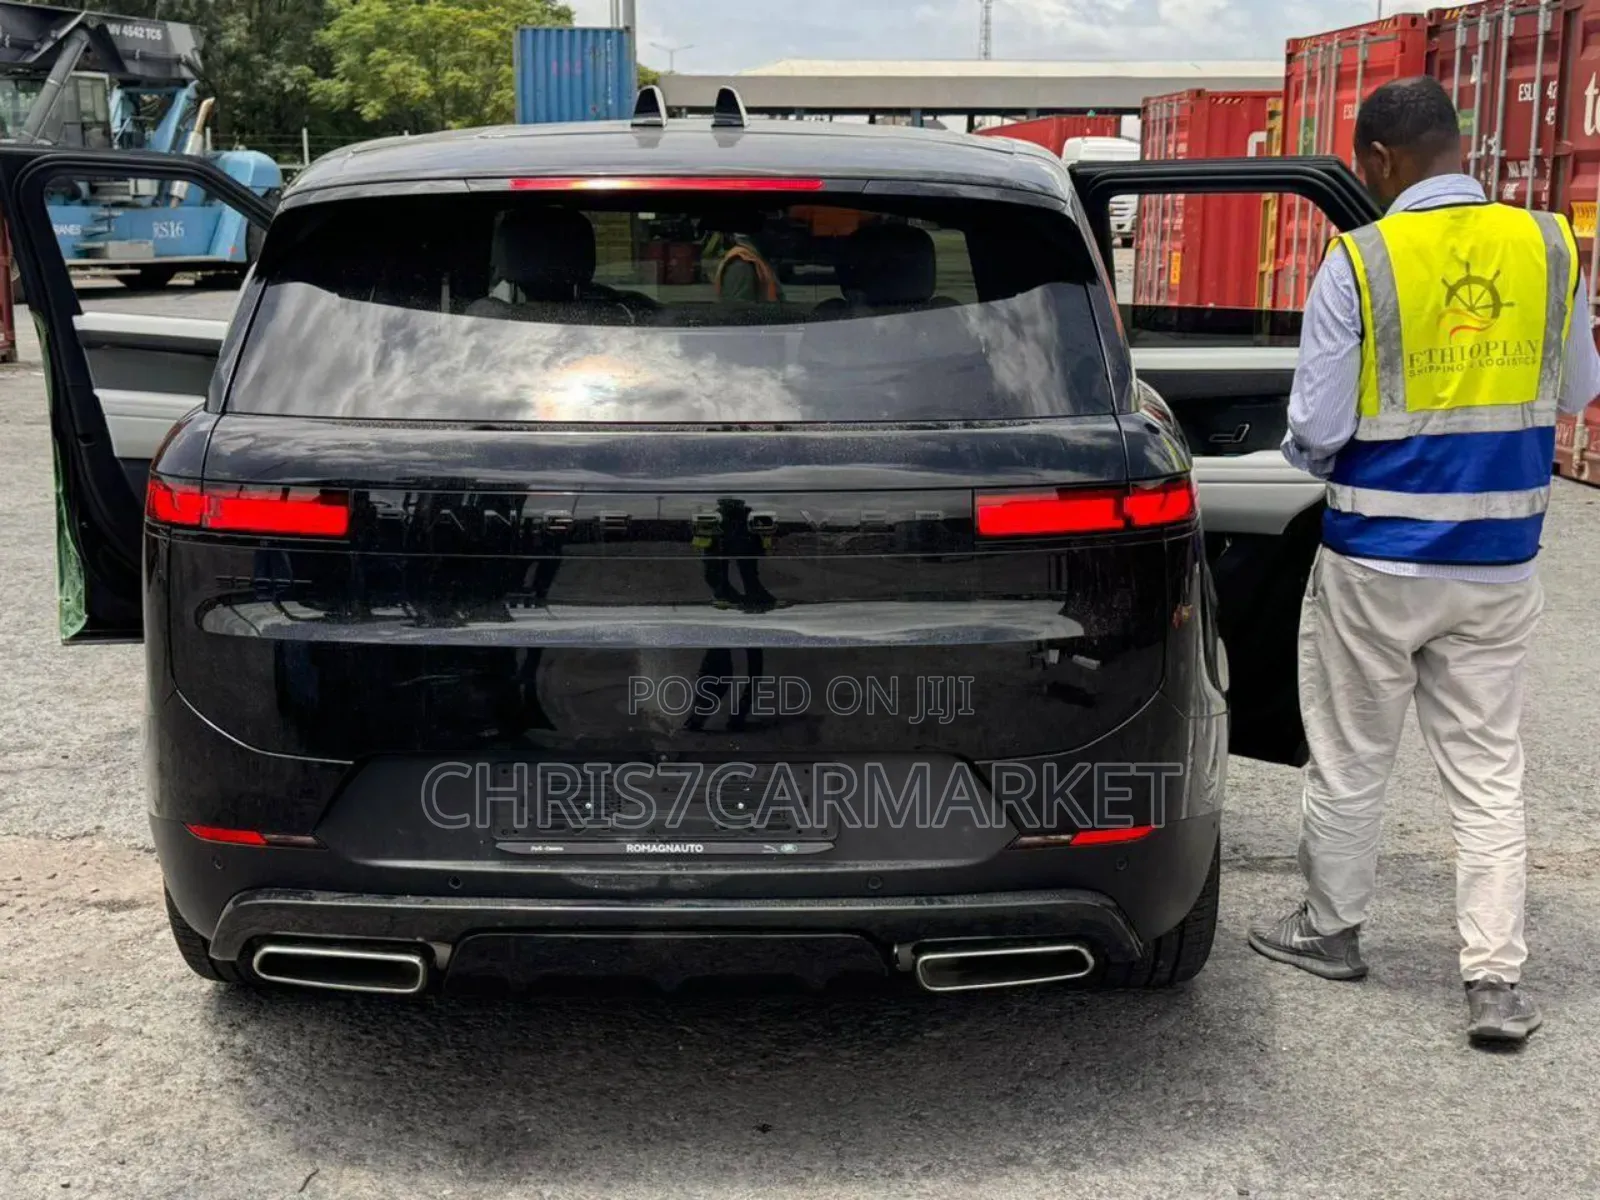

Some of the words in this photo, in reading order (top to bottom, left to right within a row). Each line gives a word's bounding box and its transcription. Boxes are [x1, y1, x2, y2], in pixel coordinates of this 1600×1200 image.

[1518, 82, 1541, 101] ESL
[1408, 339, 1540, 369] ETHIOPIAN
[625, 843, 704, 855] ROMAGNAUTO
